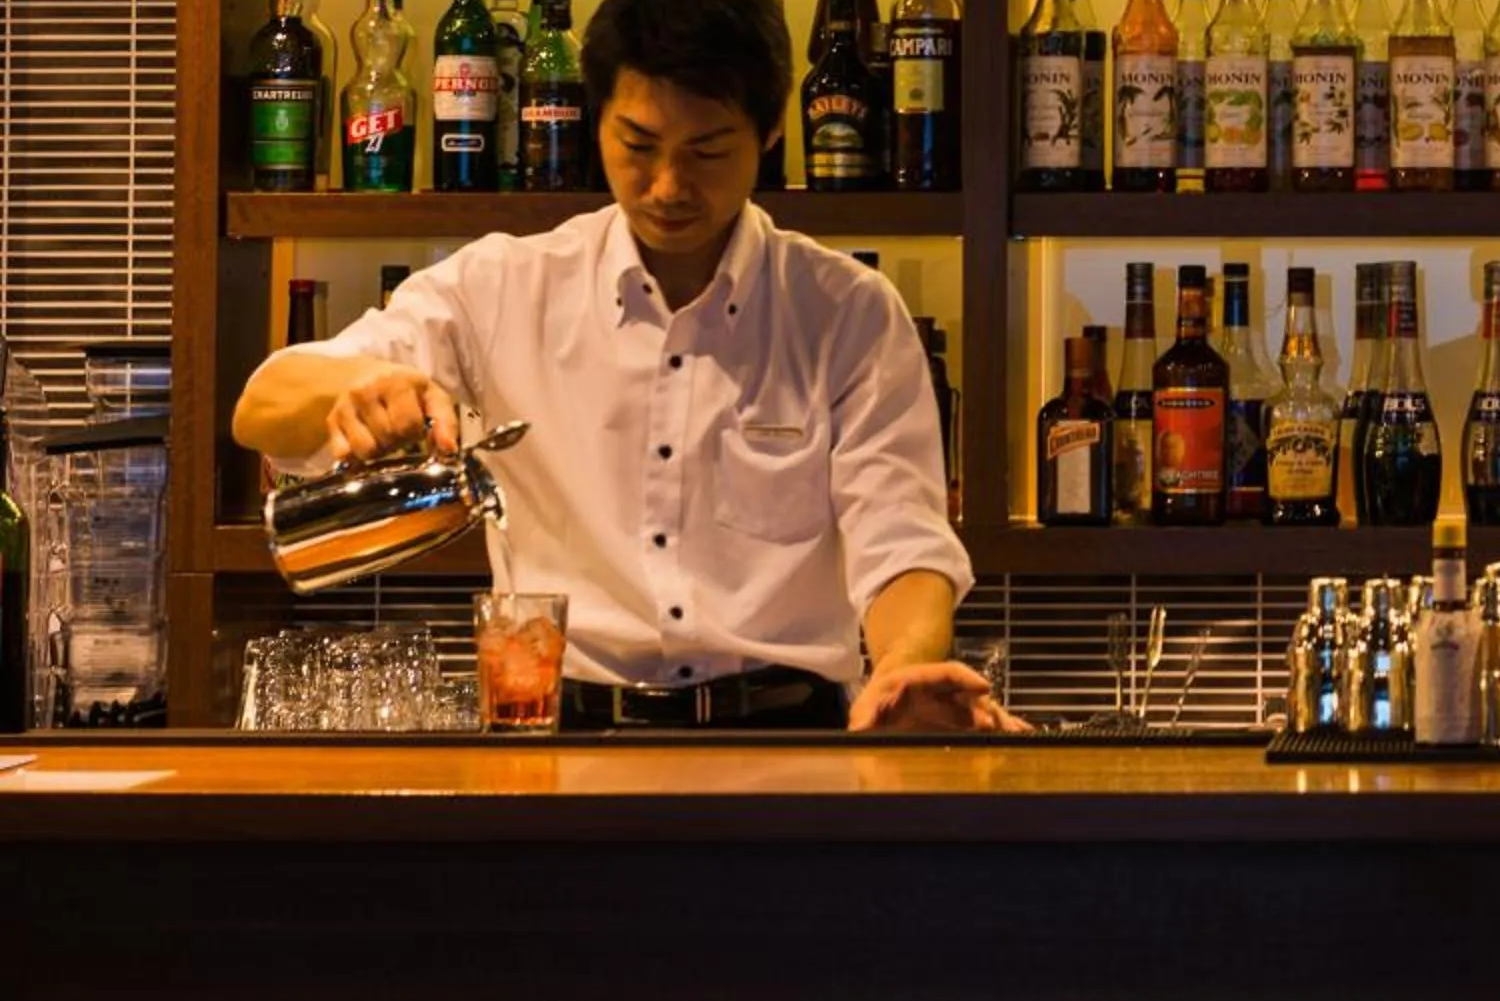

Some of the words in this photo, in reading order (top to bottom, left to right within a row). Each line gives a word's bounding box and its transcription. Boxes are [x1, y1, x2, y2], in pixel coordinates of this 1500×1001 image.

[890, 38, 952, 56] CAMPARI
[1206, 72, 1262, 85] MONIN
[1396, 72, 1449, 85] MONIN
[350, 109, 398, 138] GET
